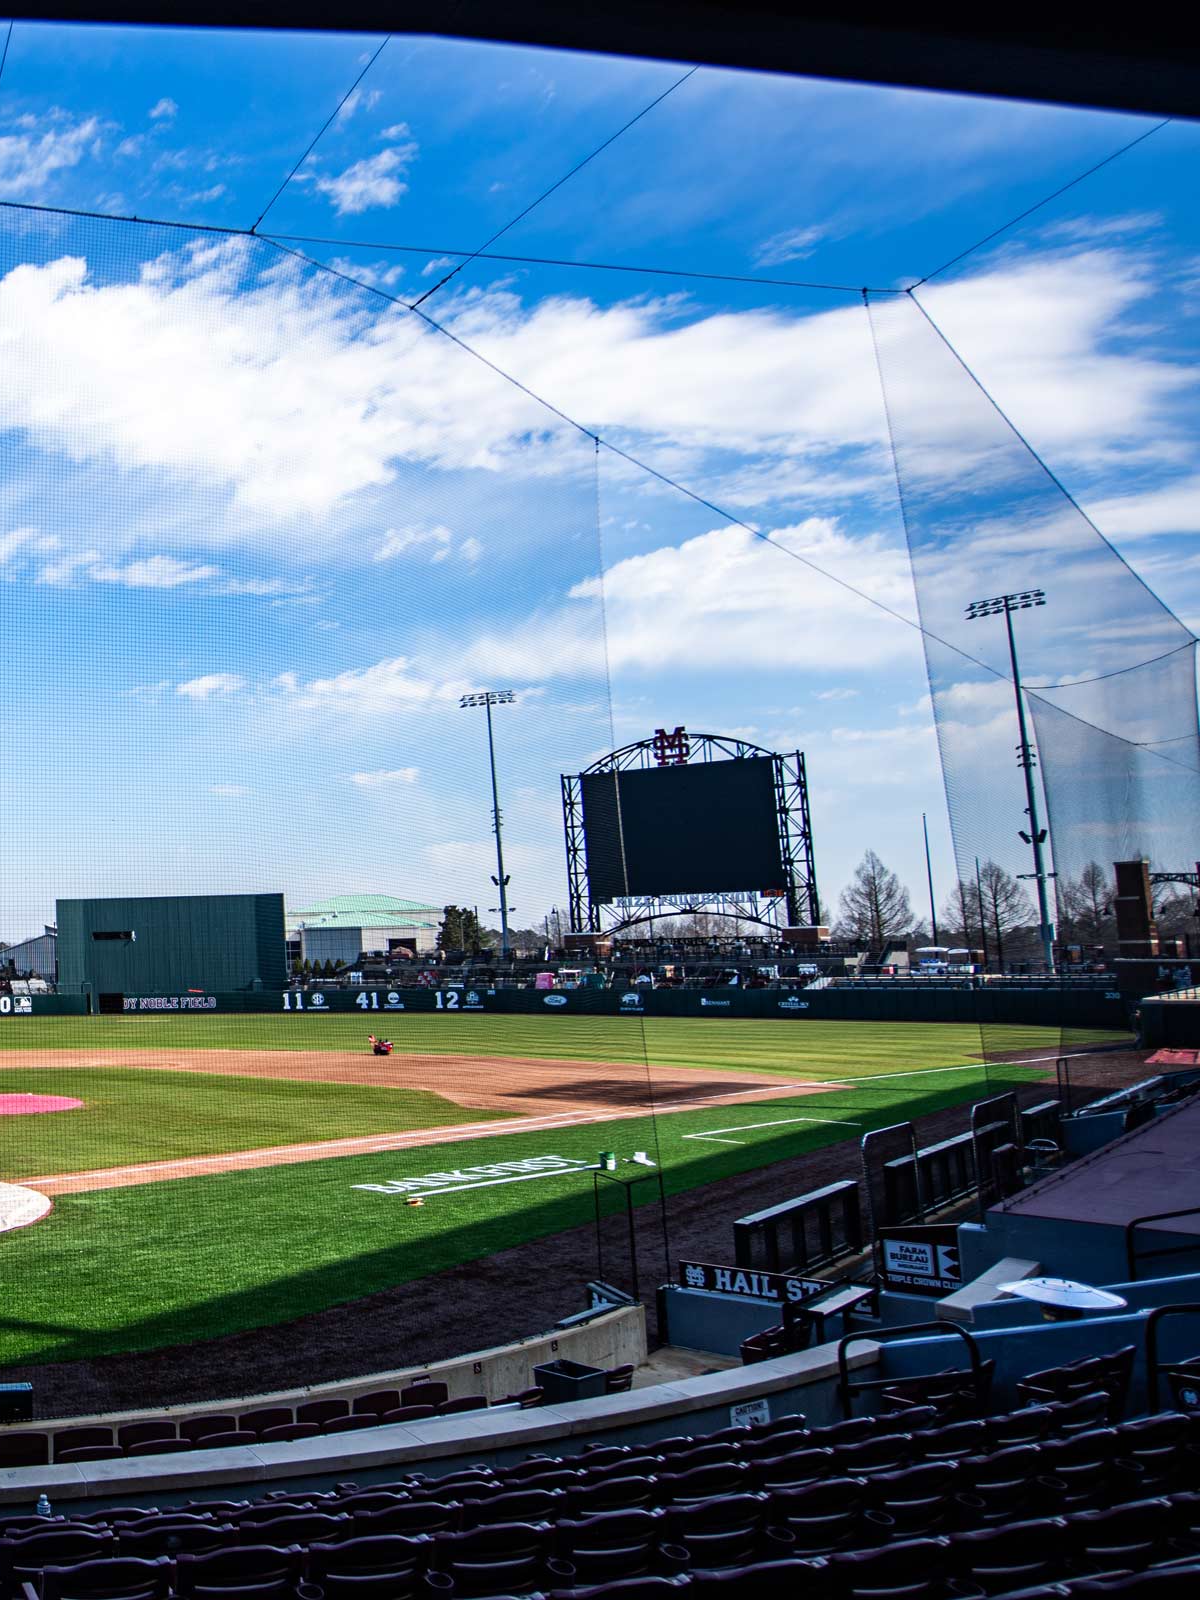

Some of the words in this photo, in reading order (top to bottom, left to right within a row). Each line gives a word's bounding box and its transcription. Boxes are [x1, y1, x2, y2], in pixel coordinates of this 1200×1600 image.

[139, 997, 179, 1009] NOBLE
[180, 997, 217, 1008] FIELD
[282, 993, 303, 1010] 11
[355, 992, 379, 1009] 41
[434, 991, 459, 1009] 12
[899, 1245, 928, 1255] FARM
[890, 1253, 928, 1264] BUREAU
[714, 1268, 778, 1299] HAIL
[888, 1274, 912, 1284] TRIPLE
[913, 1277, 941, 1288] CROWN
